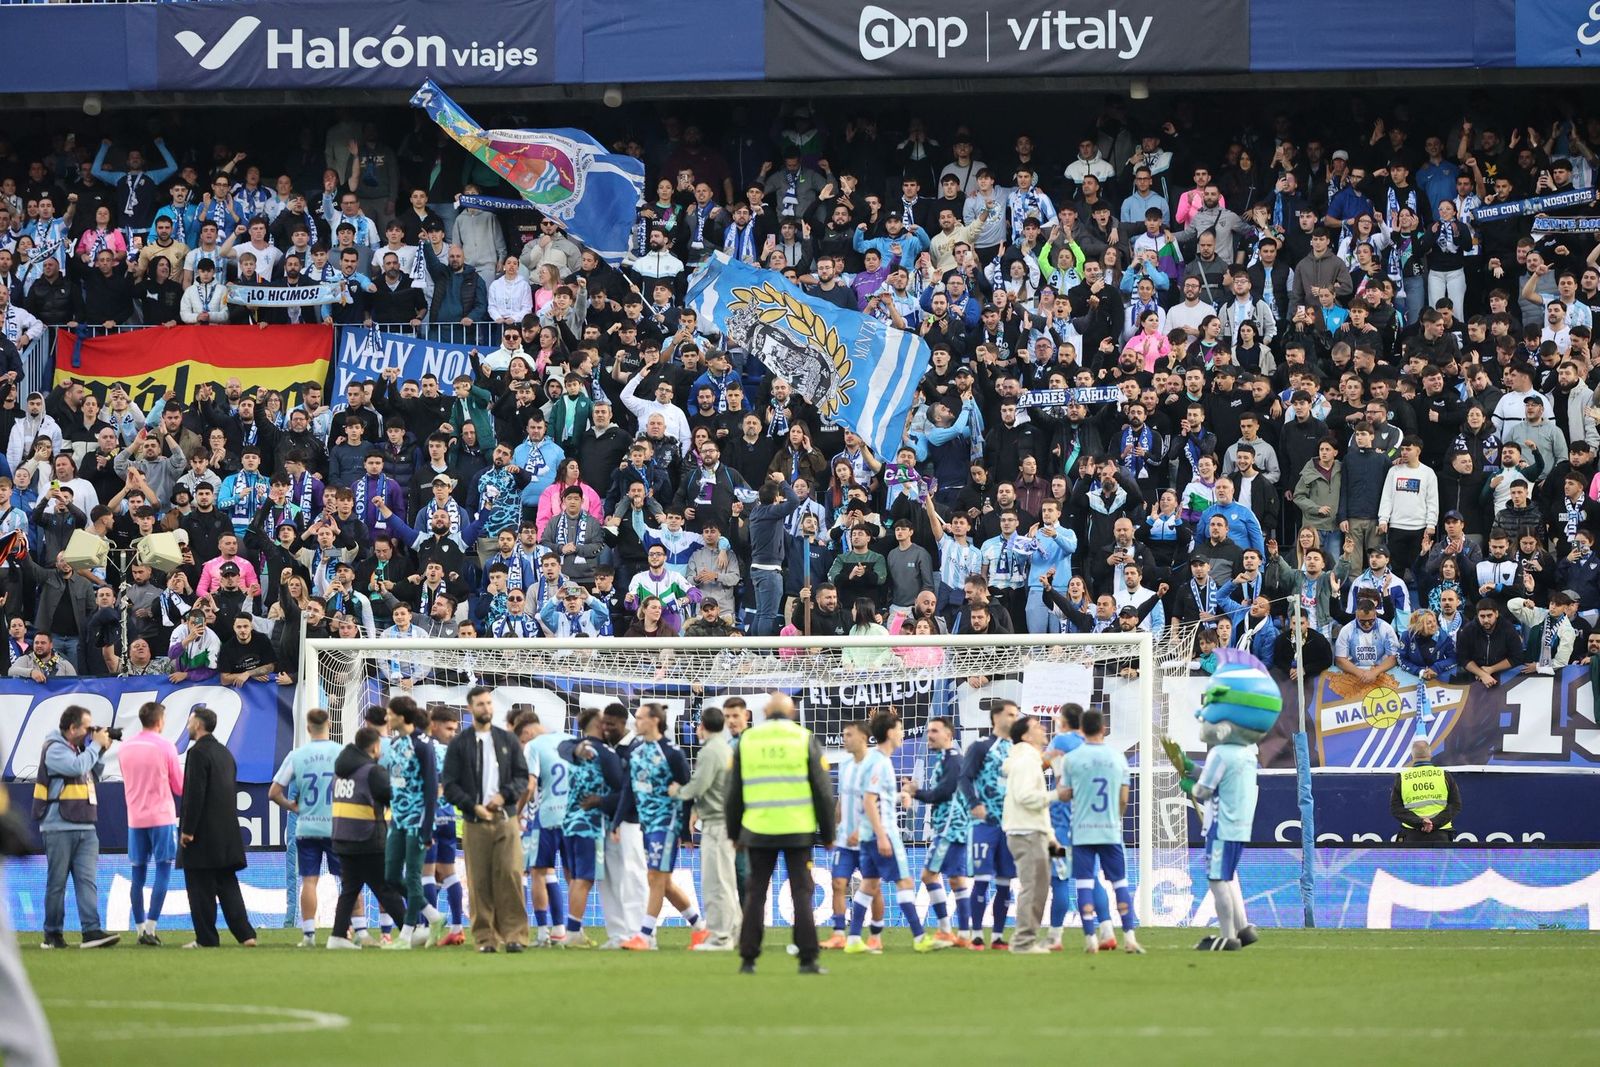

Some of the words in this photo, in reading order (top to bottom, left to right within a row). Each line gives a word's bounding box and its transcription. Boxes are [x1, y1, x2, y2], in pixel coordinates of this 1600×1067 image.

[267, 24, 447, 69] Halcón
[452, 41, 538, 71] viajes
[1477, 208, 1499, 219] DIOS
[1501, 203, 1520, 215] CON
[1543, 190, 1592, 208] NOSOTROS
[247, 290, 264, 303] ¡LO
[268, 288, 319, 301] HICIMOS!
[341, 332, 416, 378] MUY
[1019, 391, 1066, 406] PADRES
[1078, 390, 1089, 402] A
[1091, 388, 1117, 401] HIJO
[809, 679, 831, 705] EL
[838, 672, 932, 705] CALLEJO
[1335, 697, 1412, 724] MALAGA
[1404, 769, 1442, 780] SEGURIDAD
[1412, 782, 1435, 791] 0066
[302, 771, 335, 807] 37
[335, 778, 356, 799] 068
[1091, 777, 1109, 813] 3
[974, 843, 989, 859] 17
